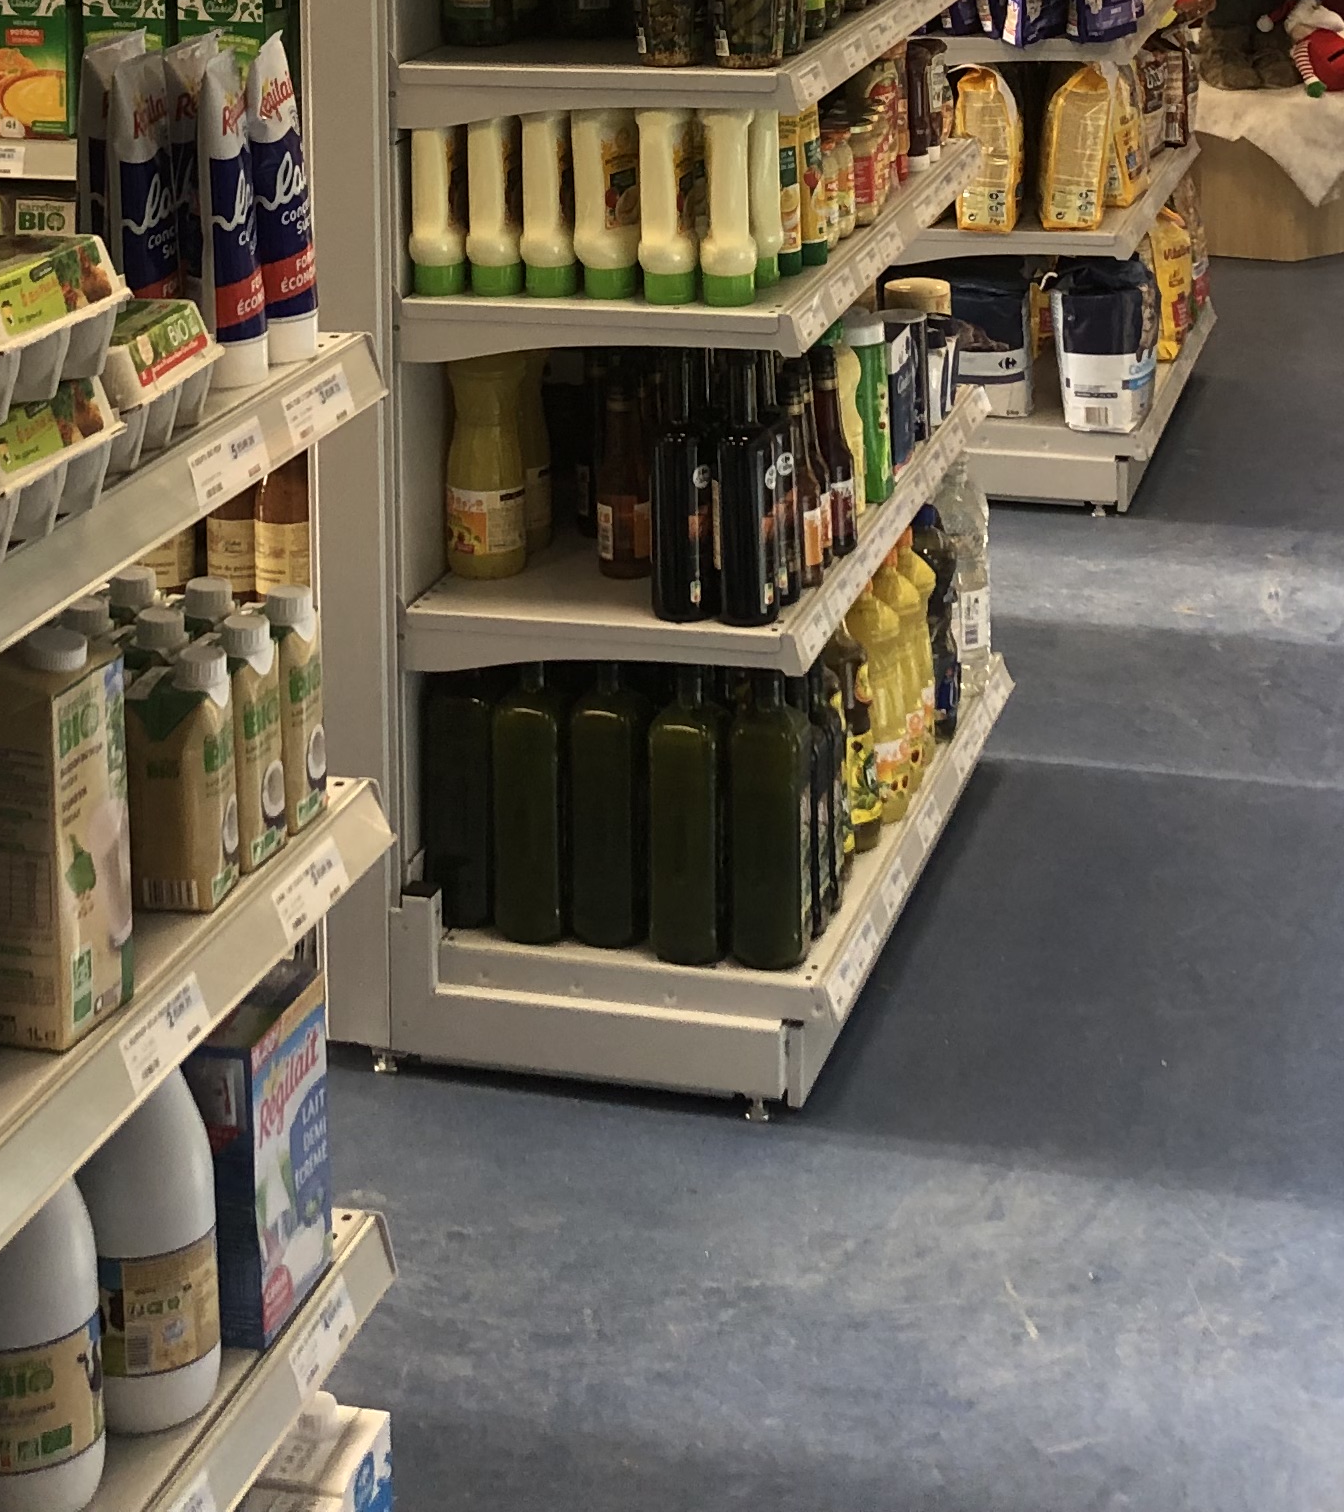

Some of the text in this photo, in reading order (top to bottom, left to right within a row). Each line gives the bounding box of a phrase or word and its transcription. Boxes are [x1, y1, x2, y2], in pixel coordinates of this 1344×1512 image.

[18, 211, 66, 232] BIO
[147, 225, 175, 250] Conc
[167, 319, 189, 346] BIO
